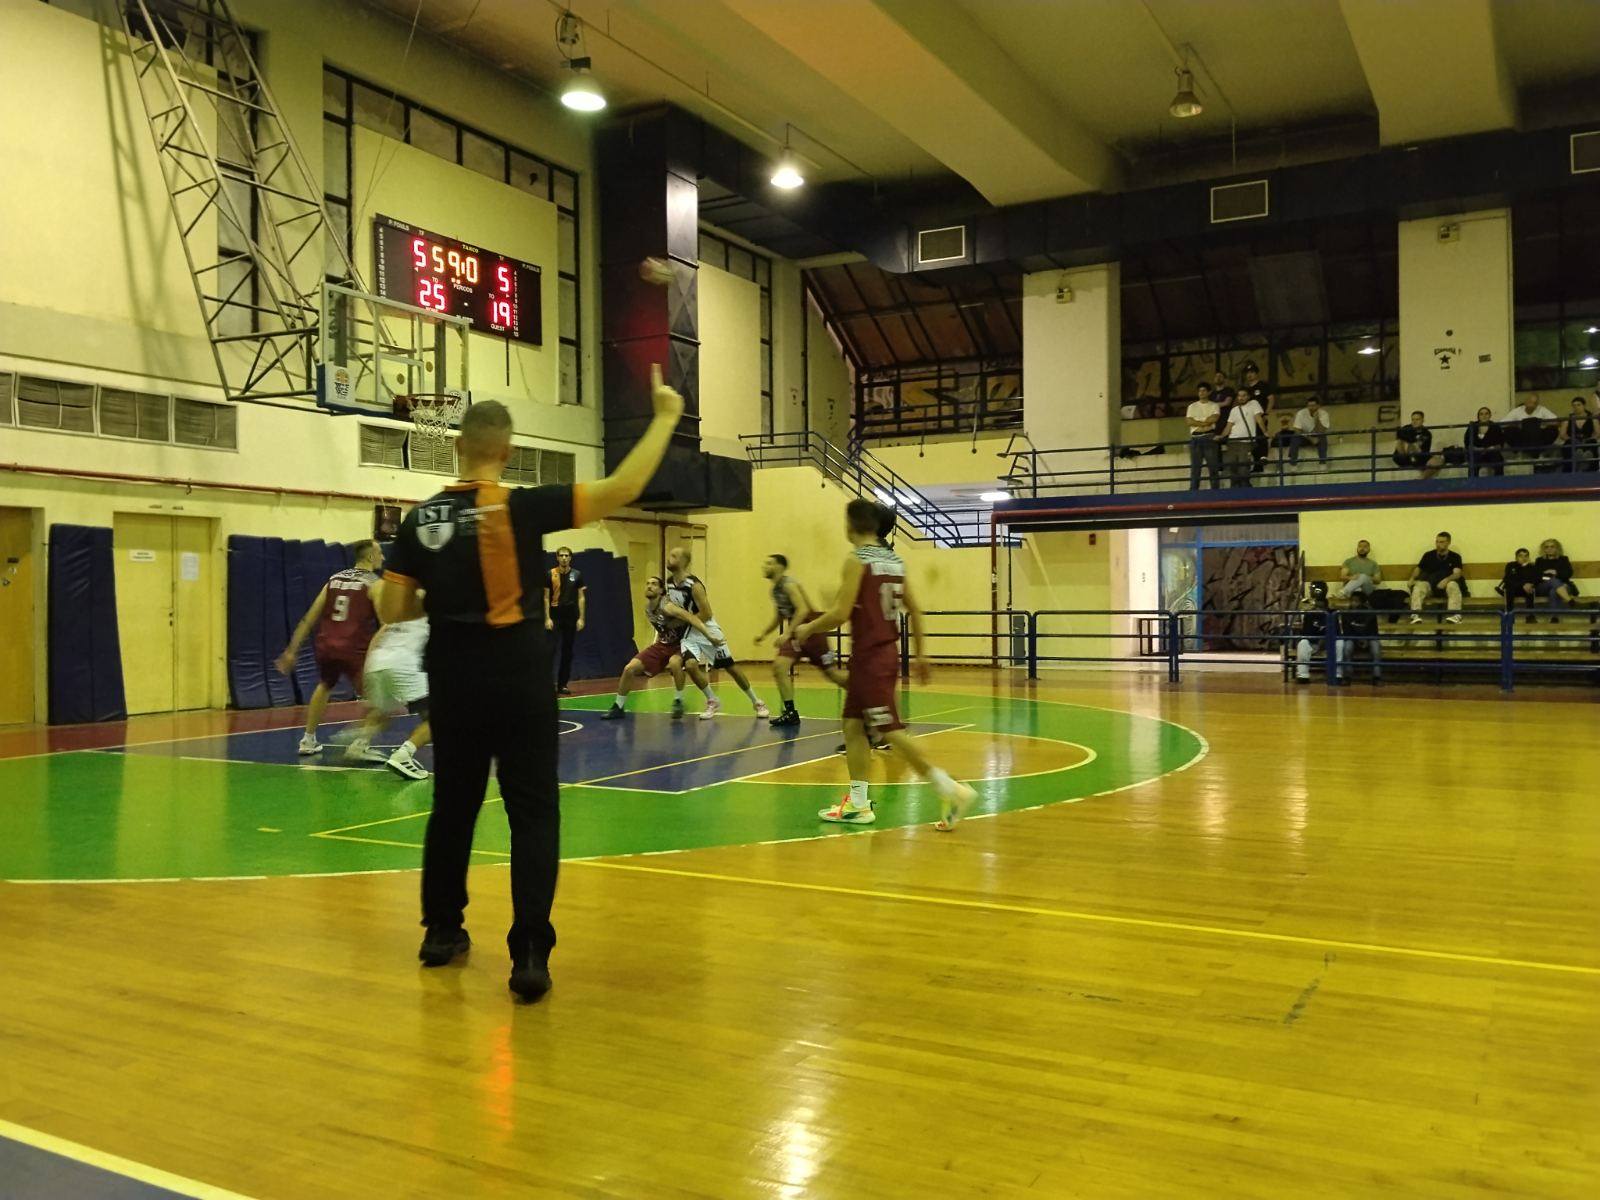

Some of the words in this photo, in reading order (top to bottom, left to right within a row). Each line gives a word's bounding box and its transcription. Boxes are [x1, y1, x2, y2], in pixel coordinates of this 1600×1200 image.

[413, 240, 426, 267] 5
[498, 266, 509, 292] 5
[420, 279, 445, 310] 25
[493, 301, 510, 326] 19
[332, 596, 349, 621] 9
